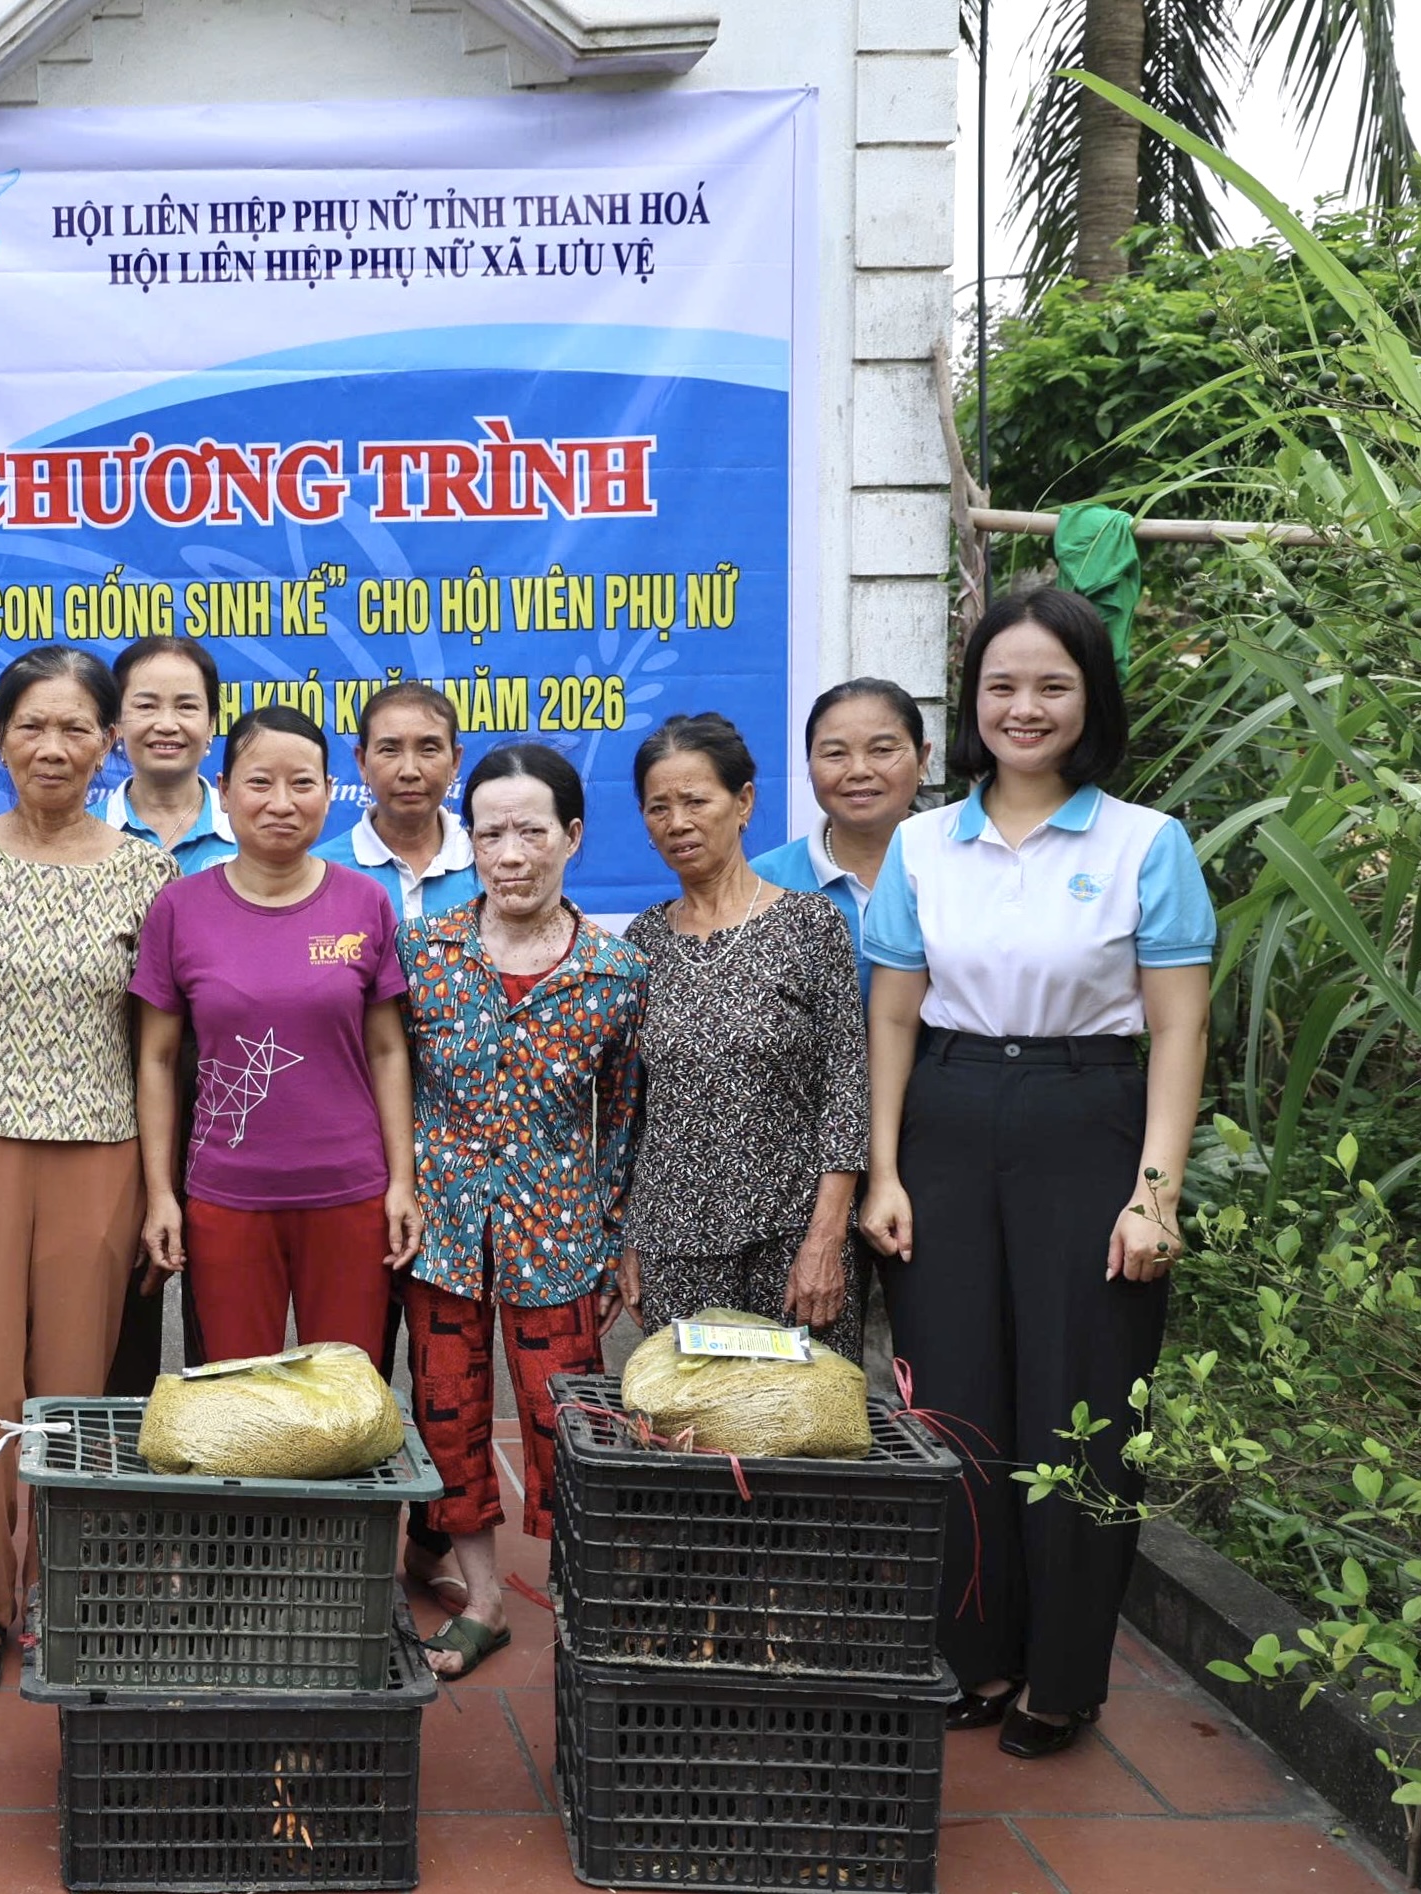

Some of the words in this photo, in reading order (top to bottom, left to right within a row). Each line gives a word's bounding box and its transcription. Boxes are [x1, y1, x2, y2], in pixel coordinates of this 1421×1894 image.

[52, 200, 114, 246] HỘI
[122, 193, 199, 235] LIÊN
[208, 195, 286, 242] HIỆP
[292, 199, 360, 240] PHỤ
[368, 190, 418, 230] NỮ
[424, 188, 506, 229] TỈNH
[513, 193, 631, 227] THANH
[639, 181, 710, 225] HOÁ
[108, 247, 170, 293] HỘI
[178, 240, 256, 283] LIÊN
[264, 244, 342, 289] HIỆP
[349, 247, 416, 287] PHỤ
[425, 237, 475, 278] NỮ
[481, 236, 528, 276] XÃ
[535, 237, 605, 276] LƯU
[612, 237, 655, 284] VỆ
[358, 416, 657, 523] TRÌNH
[64, 564, 174, 639] GIỐNG
[184, 581, 271, 638] SINH
[358, 577, 429, 635] CHO
[439, 566, 500, 645] HỘI
[510, 563, 594, 631] VIÊN
[604, 573, 676, 642] PHỤ
[686, 563, 740, 629] NỮ
[443, 665, 528, 732] NĂM
[538, 675, 626, 731] 2026
